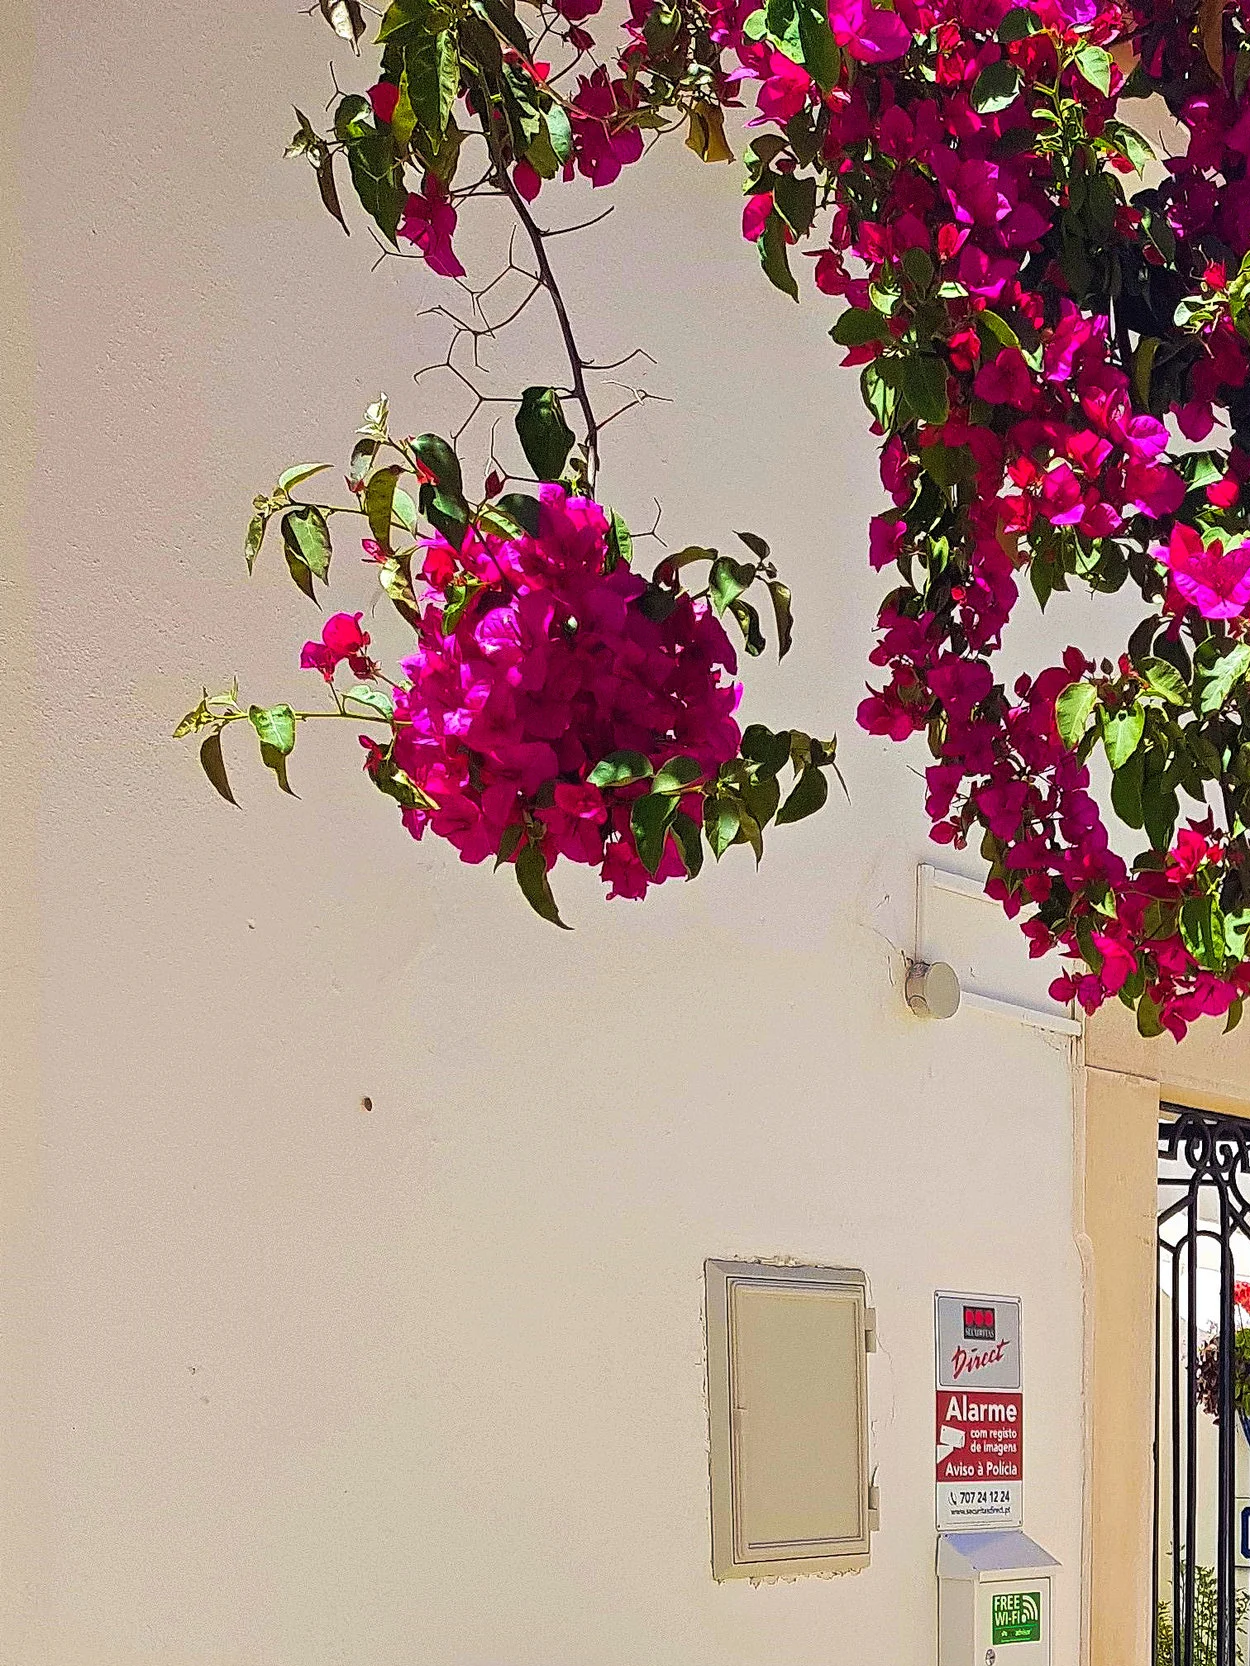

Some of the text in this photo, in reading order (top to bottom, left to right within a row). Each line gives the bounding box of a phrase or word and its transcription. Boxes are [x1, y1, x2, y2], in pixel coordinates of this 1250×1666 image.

[951, 1339, 1011, 1380] Direct
[945, 1394, 1018, 1423] Alarme
[970, 1427, 1018, 1442] com registo
[970, 1440, 982, 1453] de
[945, 1461, 975, 1477] Aviso
[977, 1461, 984, 1476] à
[960, 1490, 1010, 1504] 707 24 12 24
[994, 1595, 1021, 1612] FREE
[994, 1610, 1021, 1627] WI-FI
